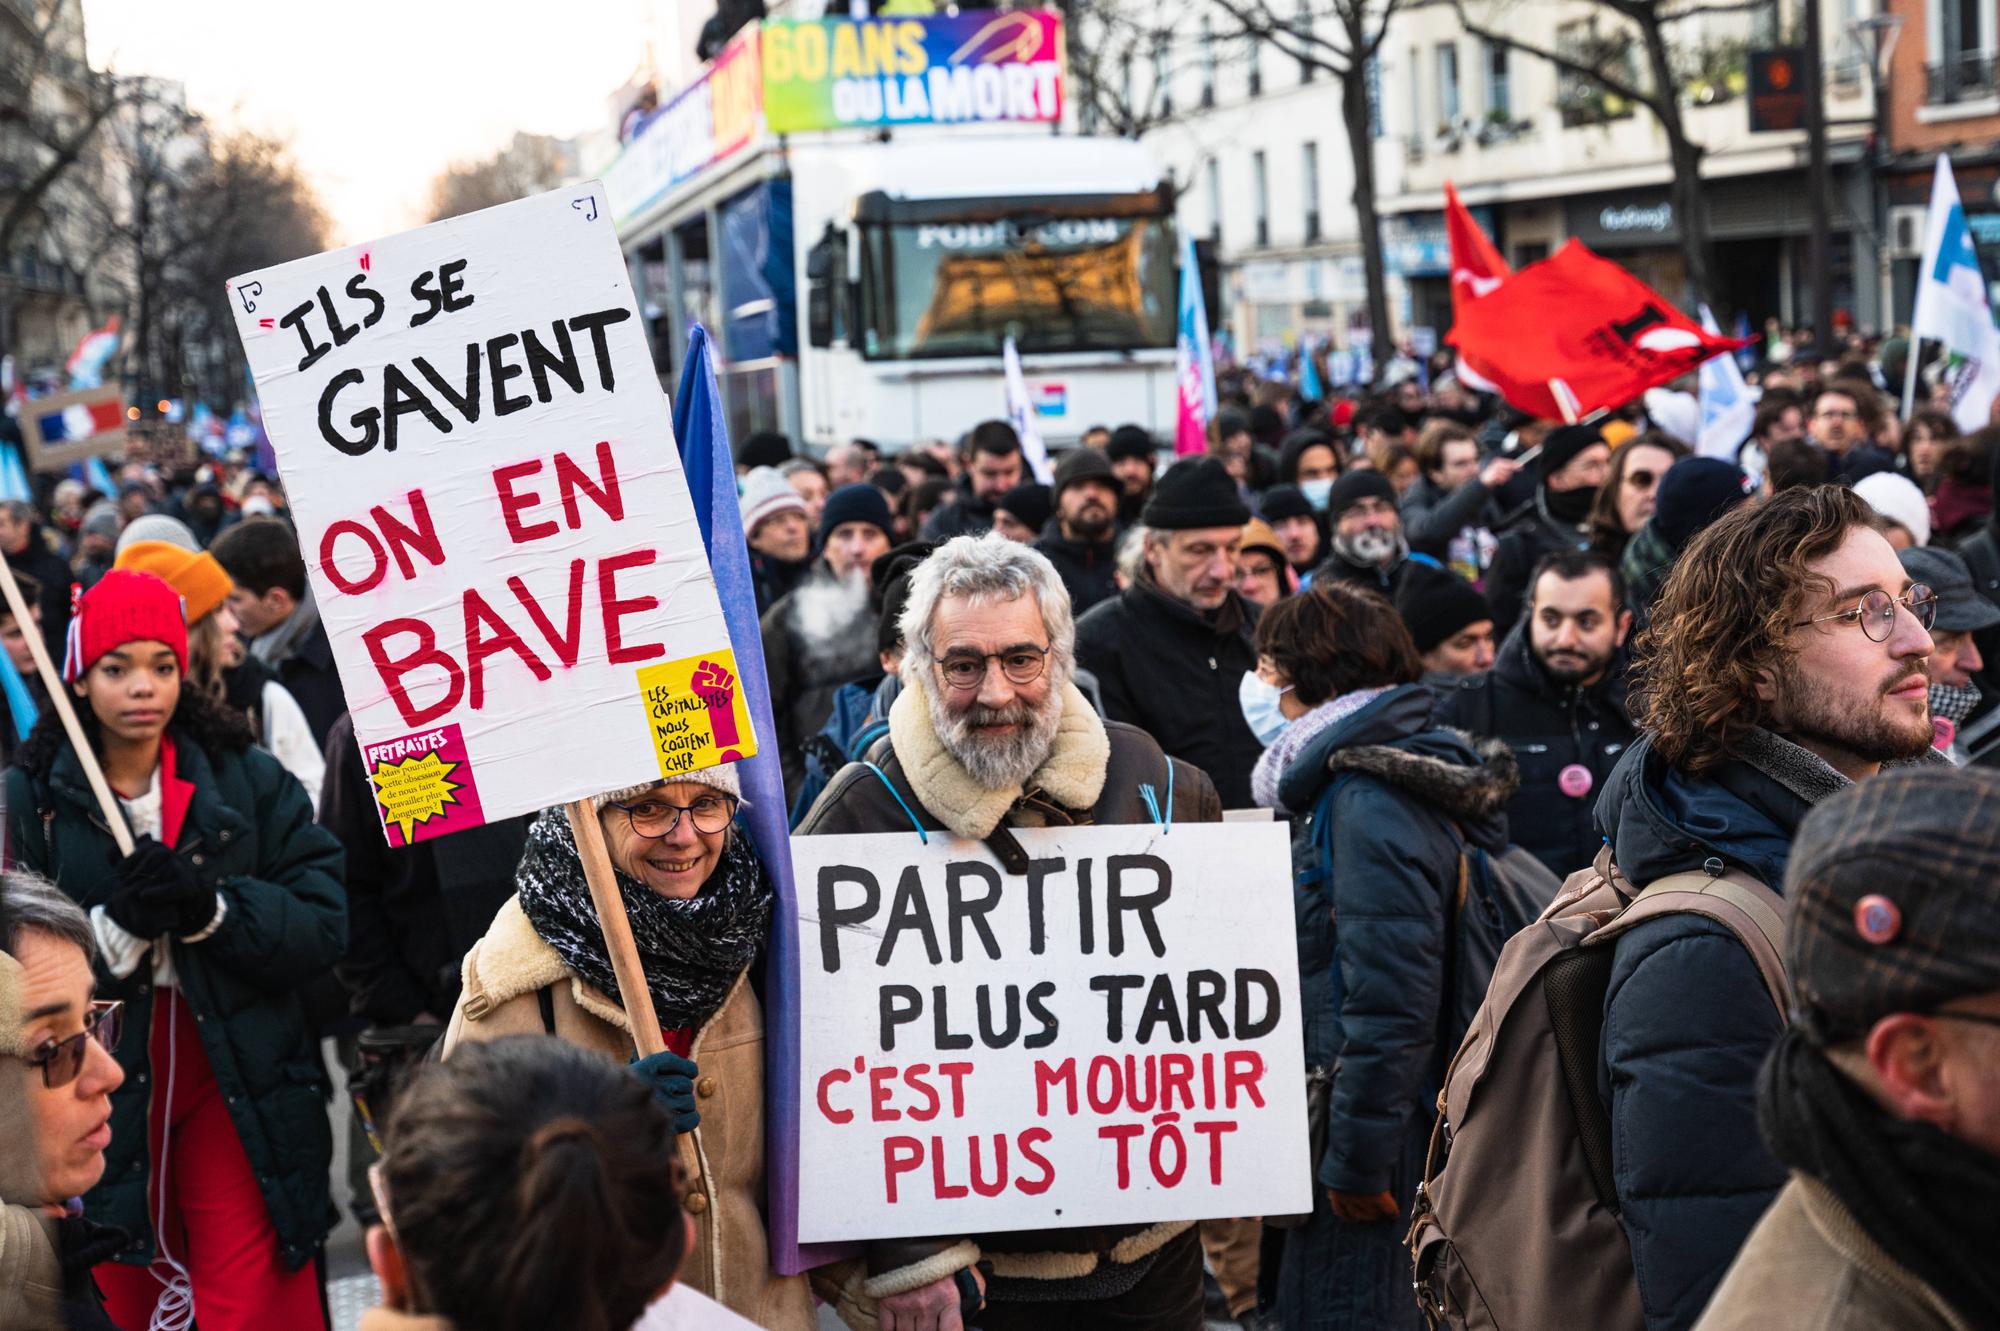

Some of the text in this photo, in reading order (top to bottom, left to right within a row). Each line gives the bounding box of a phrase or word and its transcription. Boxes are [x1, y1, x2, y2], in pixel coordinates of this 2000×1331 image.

[766, 21, 929, 82] 60 ANS
[832, 60, 1060, 122] OU LA MORT
[280, 258, 475, 372] ILS SE
[317, 307, 631, 457] GAVENT
[319, 441, 625, 596] ON EN
[361, 549, 666, 728] BAVE
[648, 686, 669, 703] LES
[656, 718, 689, 739] NOUS
[661, 732, 710, 754] COÛTENT
[381, 760, 439, 778] Mais pourquoi
[384, 769, 441, 789] cette obsession
[387, 781, 437, 799] de nous faire
[665, 752, 694, 771] CHER
[390, 791, 443, 809] travailler plus
[817, 853, 1172, 973] PARTIR
[879, 968, 1282, 1051] PLUS TARD
[816, 1050, 1265, 1124] C'EST MOURIR
[883, 1127, 1056, 1203] PLUS
